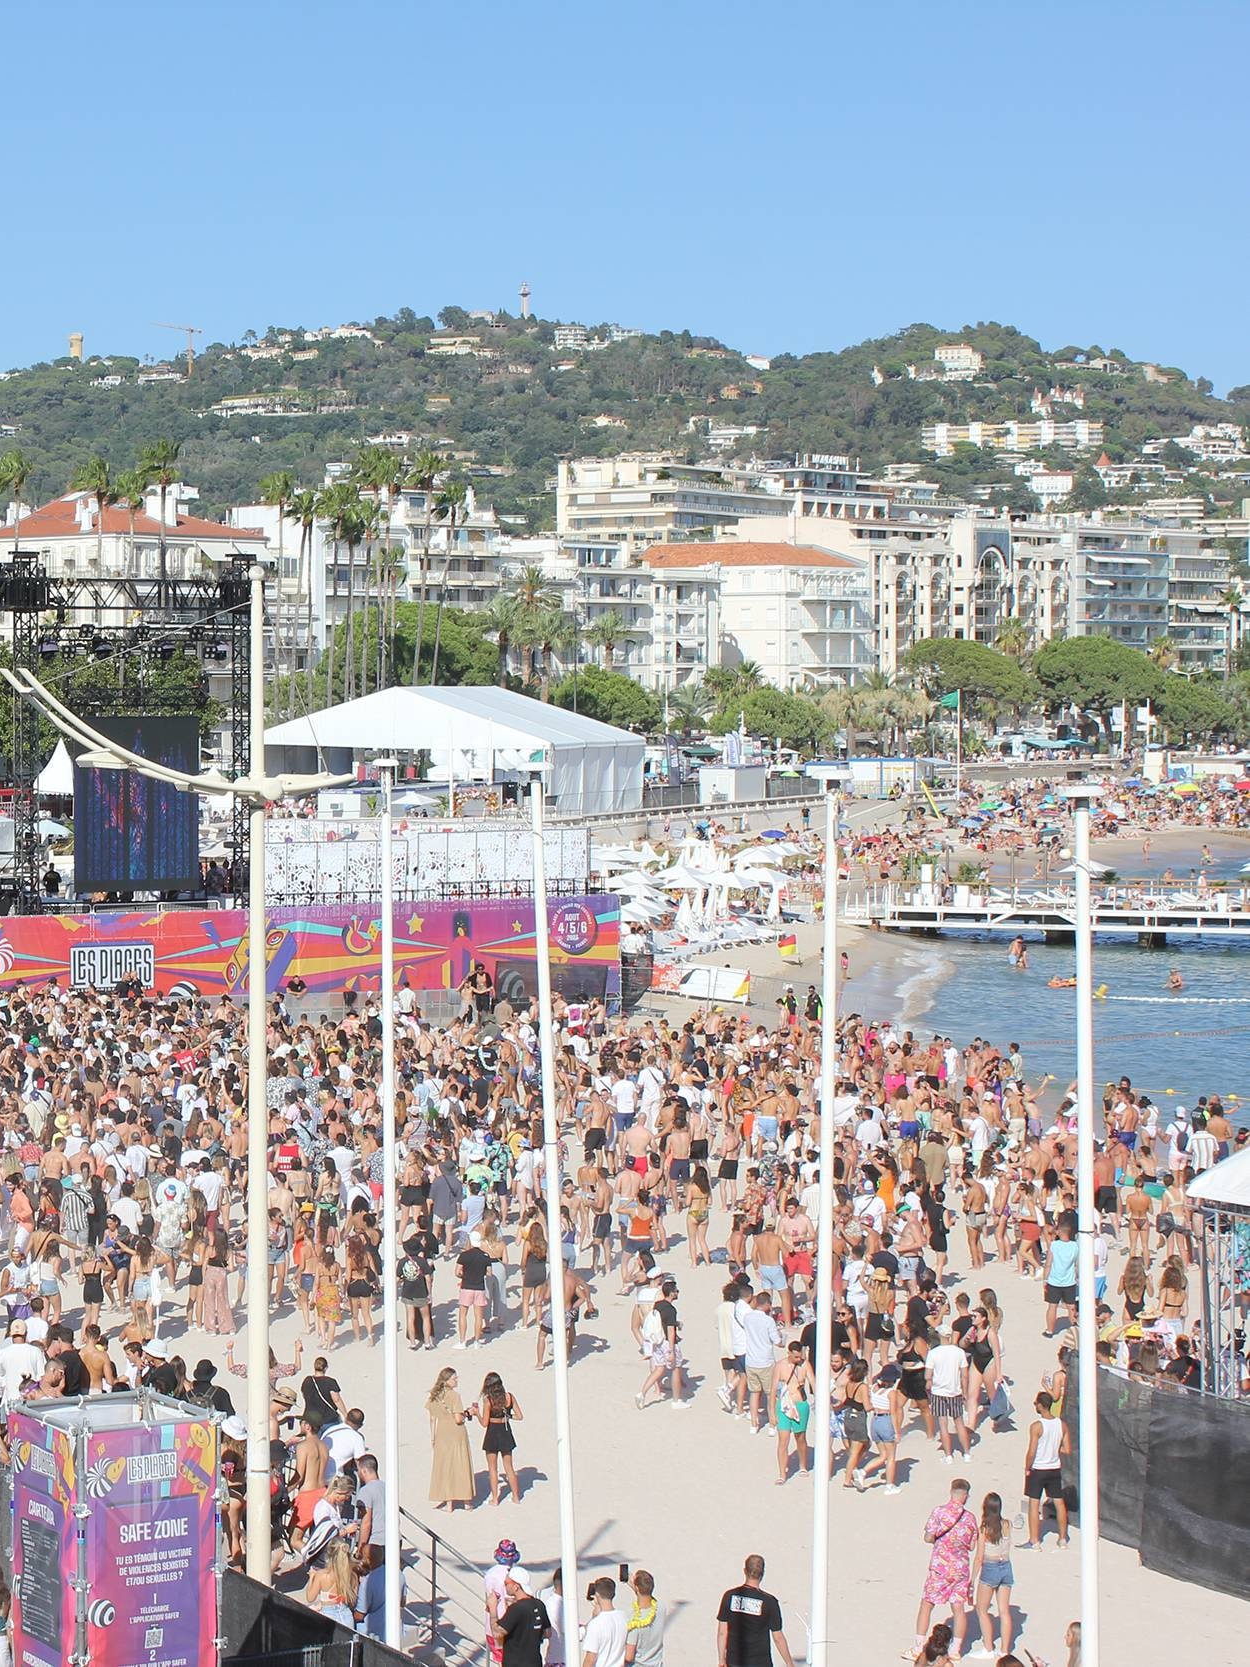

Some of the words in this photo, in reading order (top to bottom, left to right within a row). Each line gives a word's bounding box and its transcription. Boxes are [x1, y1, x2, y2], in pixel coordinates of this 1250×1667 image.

[557, 921, 588, 934] 4/5/6
[73, 949, 96, 985] LES
[100, 948, 152, 984] PLAGES
[128, 1458, 143, 1480] LES
[144, 1454, 175, 1479] PLAGES
[120, 1522, 152, 1543] SAFE
[154, 1518, 188, 1539] ZONE
[116, 1556, 124, 1565] TU
[125, 1556, 133, 1564] ES
[159, 1552, 167, 1560] OU
[168, 1547, 192, 1559] VICTIME
[119, 1567, 127, 1576] DE
[129, 1563, 161, 1575] VIOLENCES
[162, 1559, 189, 1570] SEXISTES
[126, 1576, 145, 1586] ET/OU
[146, 1572, 177, 1584] SEXUELLES
[149, 1649, 156, 1661] 2
